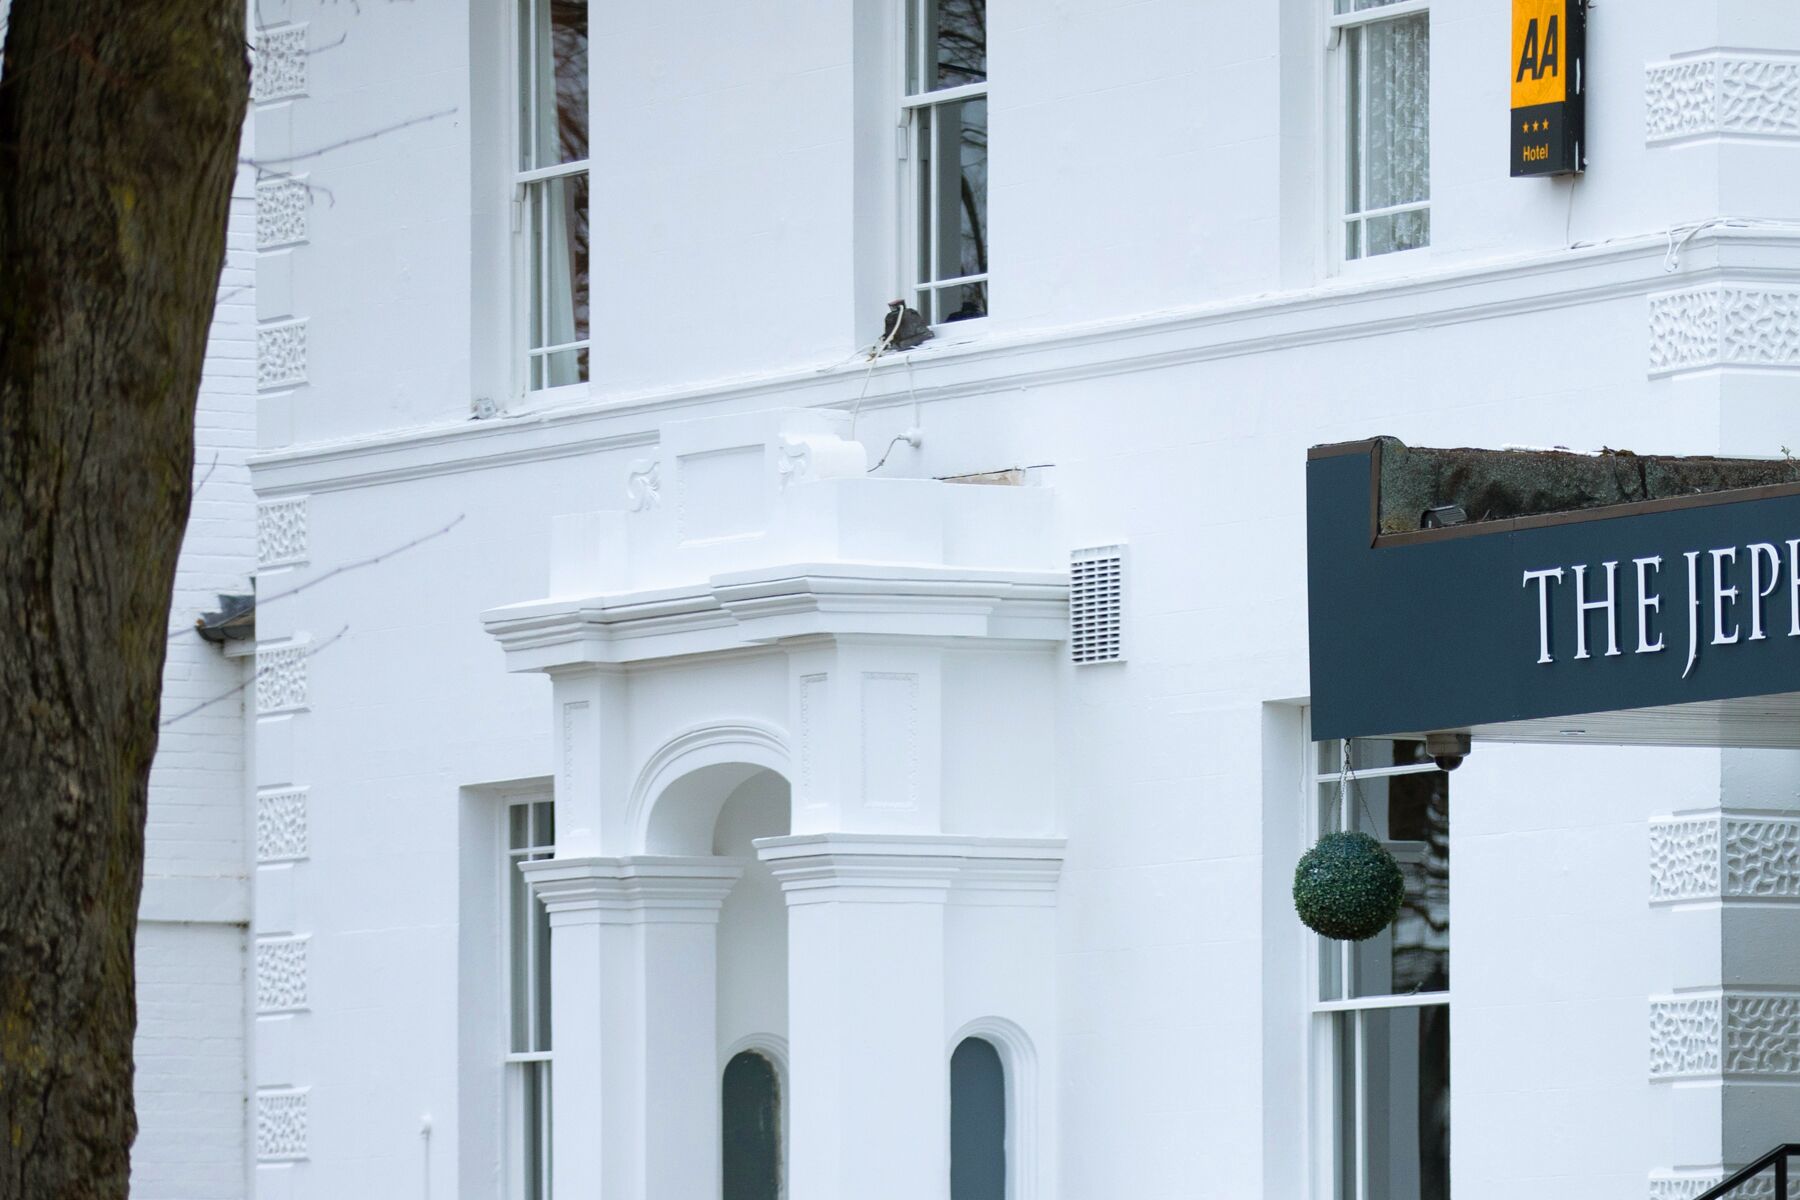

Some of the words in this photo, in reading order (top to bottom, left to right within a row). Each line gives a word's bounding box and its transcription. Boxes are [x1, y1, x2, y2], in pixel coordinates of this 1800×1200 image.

[1516, 14, 1558, 83] AA
[1523, 143, 1549, 162] Hotel
[1522, 555, 1665, 664] THE
